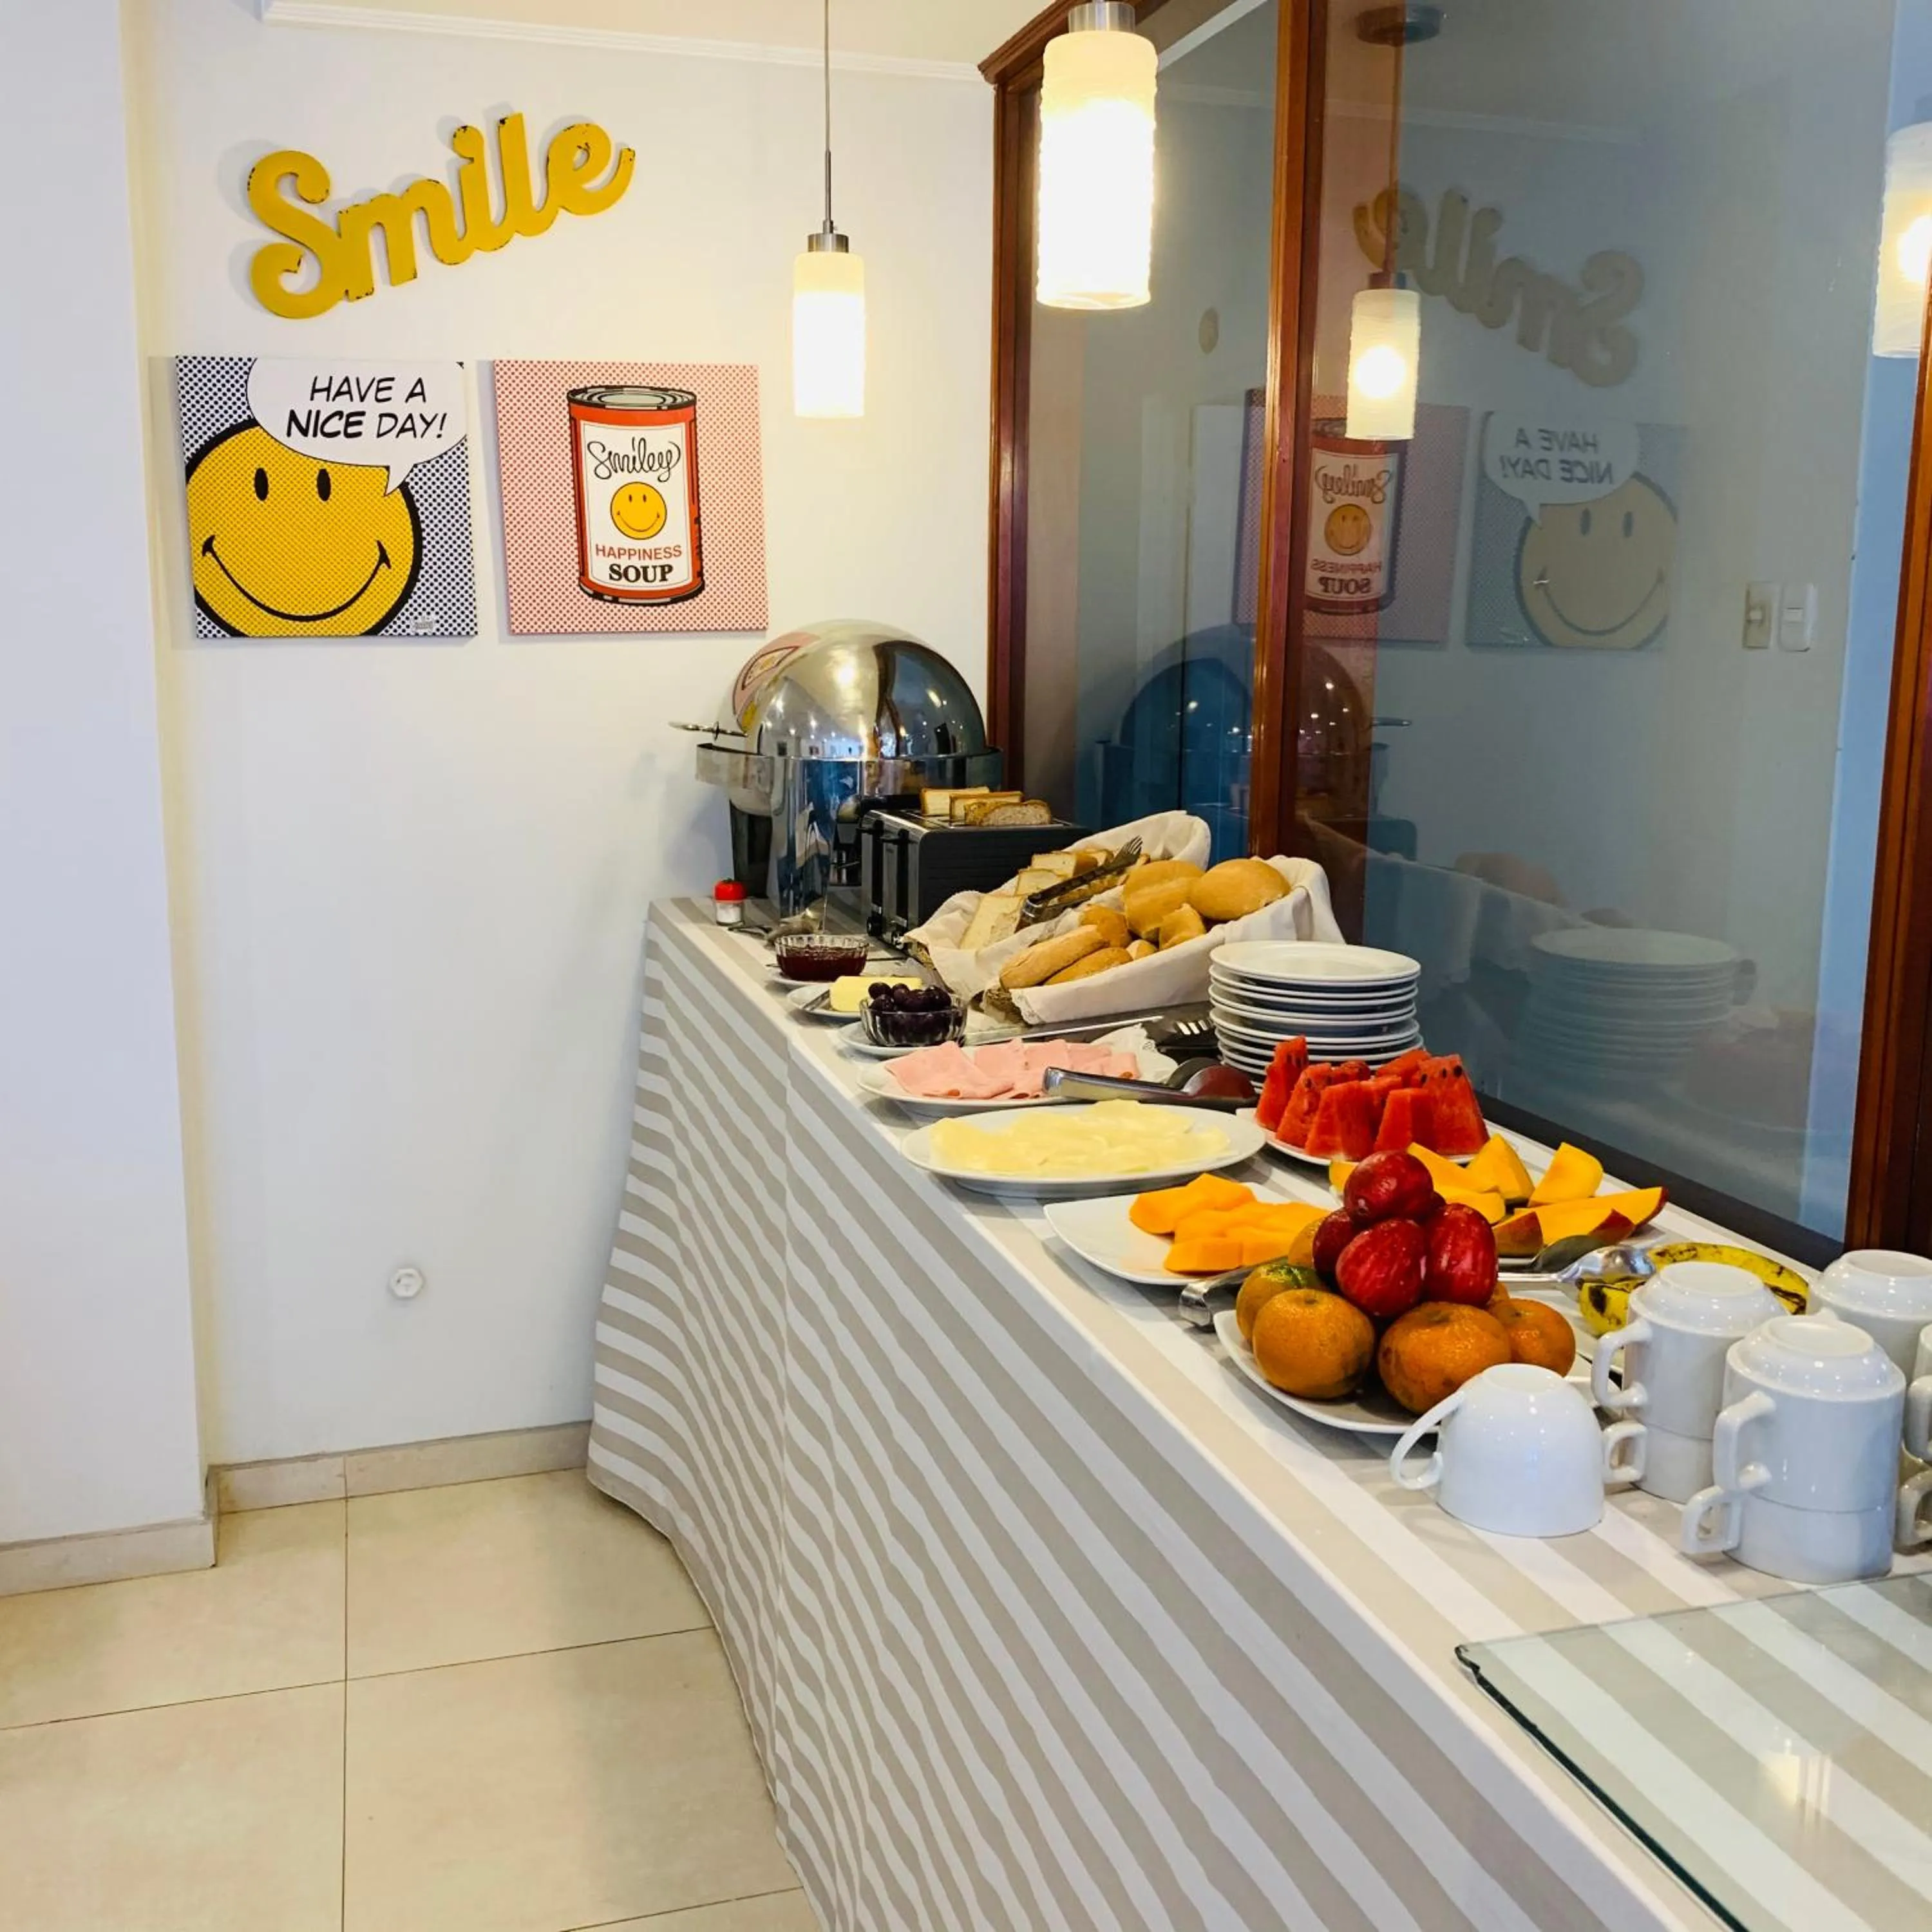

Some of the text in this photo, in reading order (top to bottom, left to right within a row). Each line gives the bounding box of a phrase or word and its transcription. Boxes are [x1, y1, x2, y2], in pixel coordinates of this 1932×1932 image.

[247, 112, 636, 319] Smile
[310, 375, 426, 403] HAVE A
[286, 409, 448, 439] NICE DAY!
[587, 436, 681, 483] Smiley
[595, 544, 683, 561] HAPPINESS
[609, 564, 674, 583] SOUP
